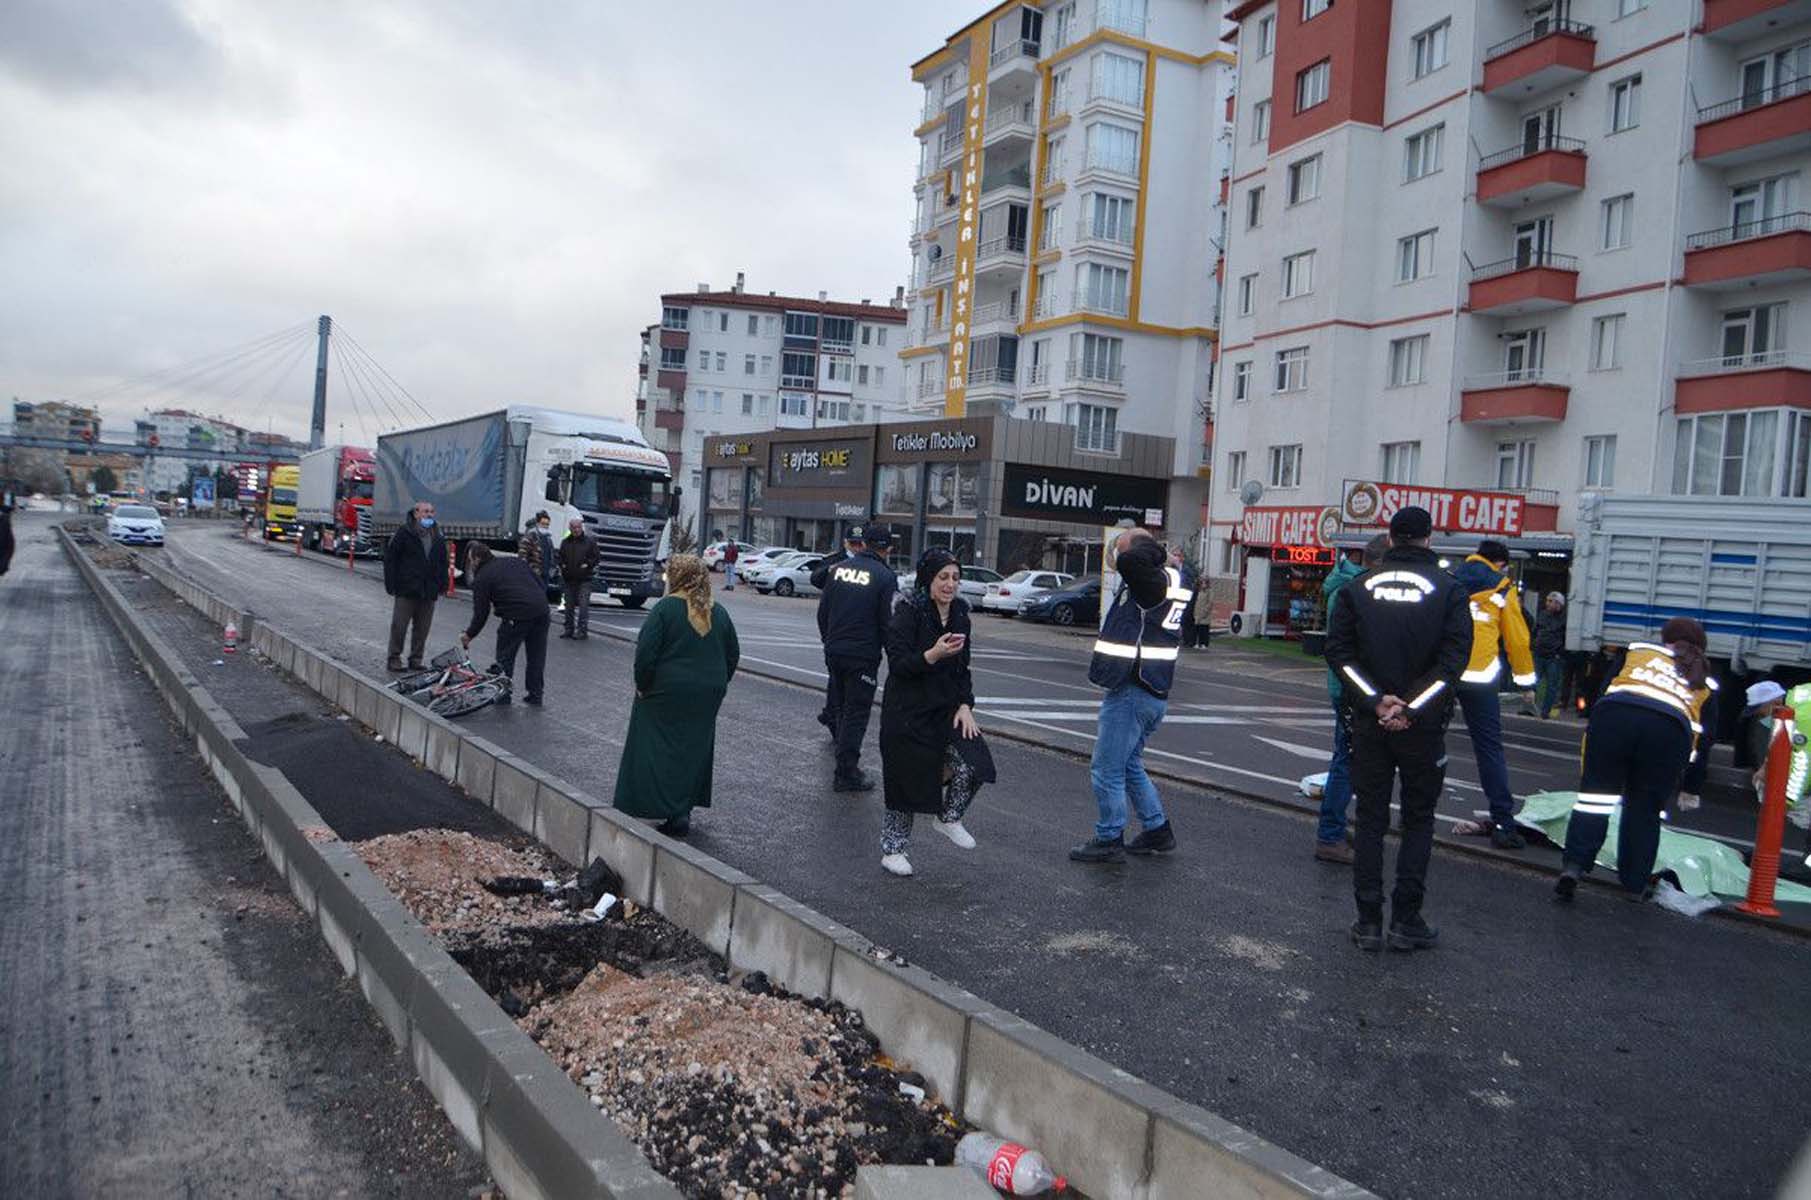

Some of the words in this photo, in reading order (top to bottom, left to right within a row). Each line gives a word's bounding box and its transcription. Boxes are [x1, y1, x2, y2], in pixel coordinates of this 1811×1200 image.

[892, 433, 928, 451] Tetikler
[930, 431, 976, 453] Mobilya
[821, 448, 849, 467] HOME
[1025, 478, 1094, 508] DİVAN
[1459, 495, 1521, 532] CAFE
[1281, 511, 1316, 545] CAFE
[1287, 546, 1319, 561] TOST
